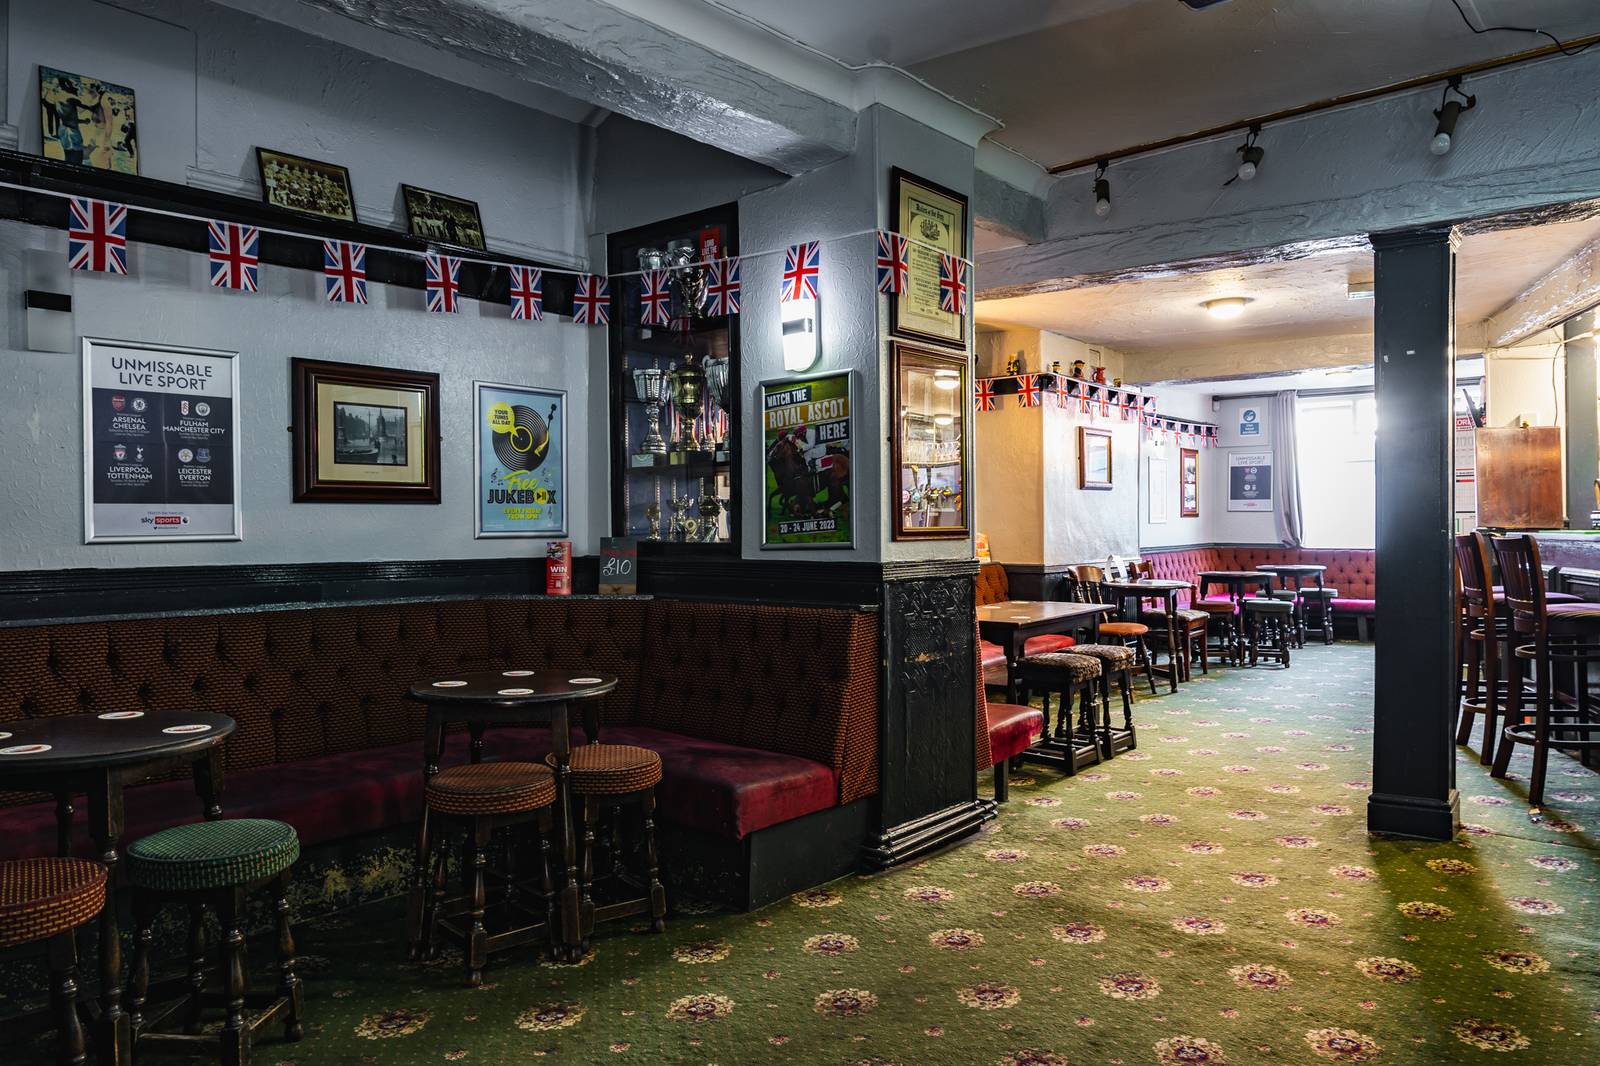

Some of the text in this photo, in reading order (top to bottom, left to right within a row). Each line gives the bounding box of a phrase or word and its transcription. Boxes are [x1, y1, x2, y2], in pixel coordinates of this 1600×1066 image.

[112, 356, 212, 378] UNMISSABLE
[120, 372, 206, 390] LIVE SPORT
[767, 388, 807, 408] WATCH THE
[770, 399, 845, 429] ROYAL ASCOT
[162, 426, 210, 434] MANCHESTER
[820, 422, 847, 440] HERE
[504, 470, 538, 494] Free
[780, 524, 788, 533] 20
[802, 521, 818, 530] JUNE
[820, 520, 835, 529] 2023
[602, 558, 632, 576] £10
